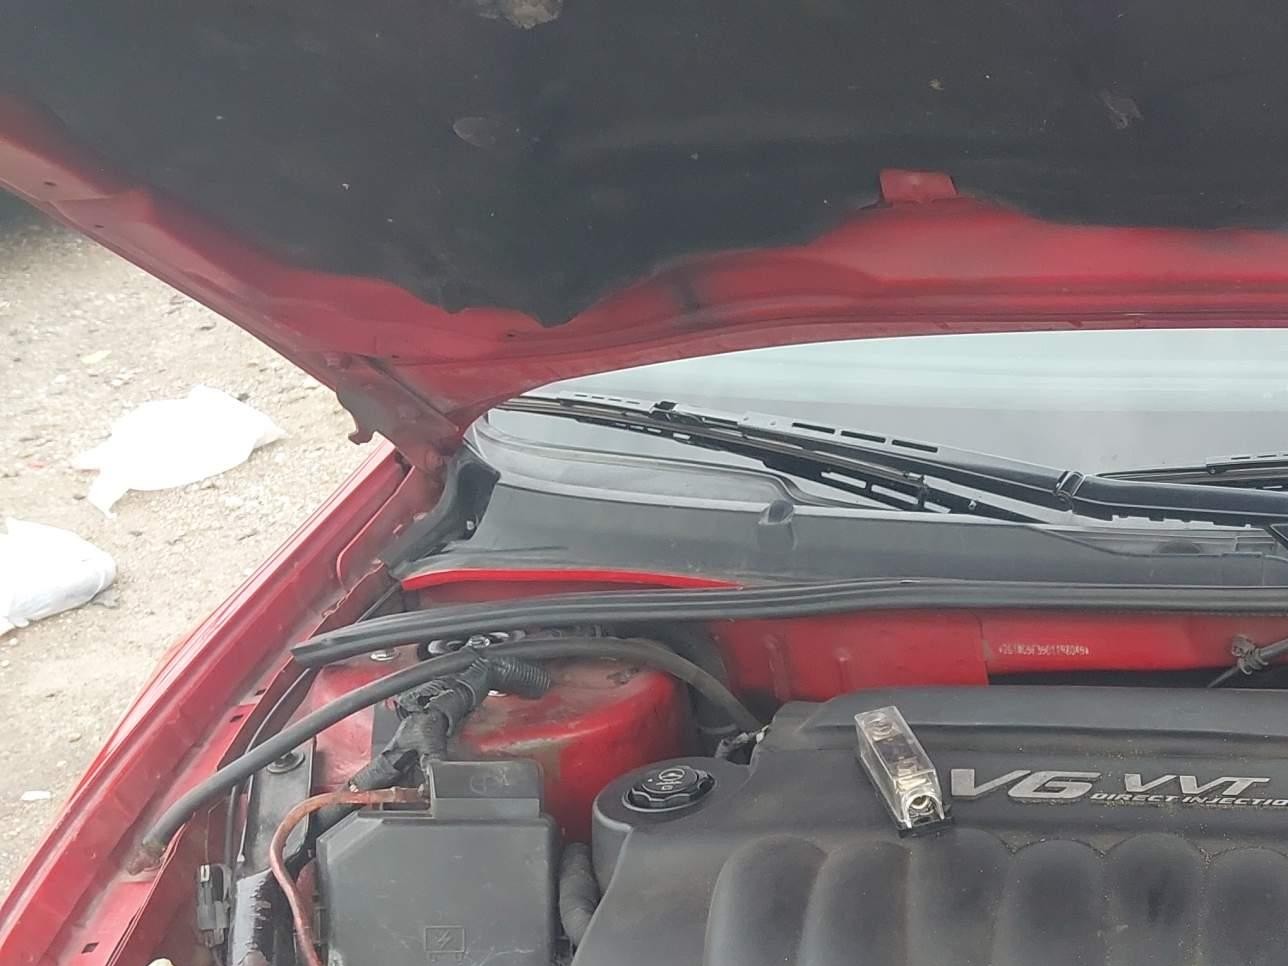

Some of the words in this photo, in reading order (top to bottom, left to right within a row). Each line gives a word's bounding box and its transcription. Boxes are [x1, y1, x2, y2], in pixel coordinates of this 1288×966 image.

[950, 768, 1101, 800] V6
[1124, 773, 1271, 796] VVT
[1090, 792, 1179, 804] DIRECT
